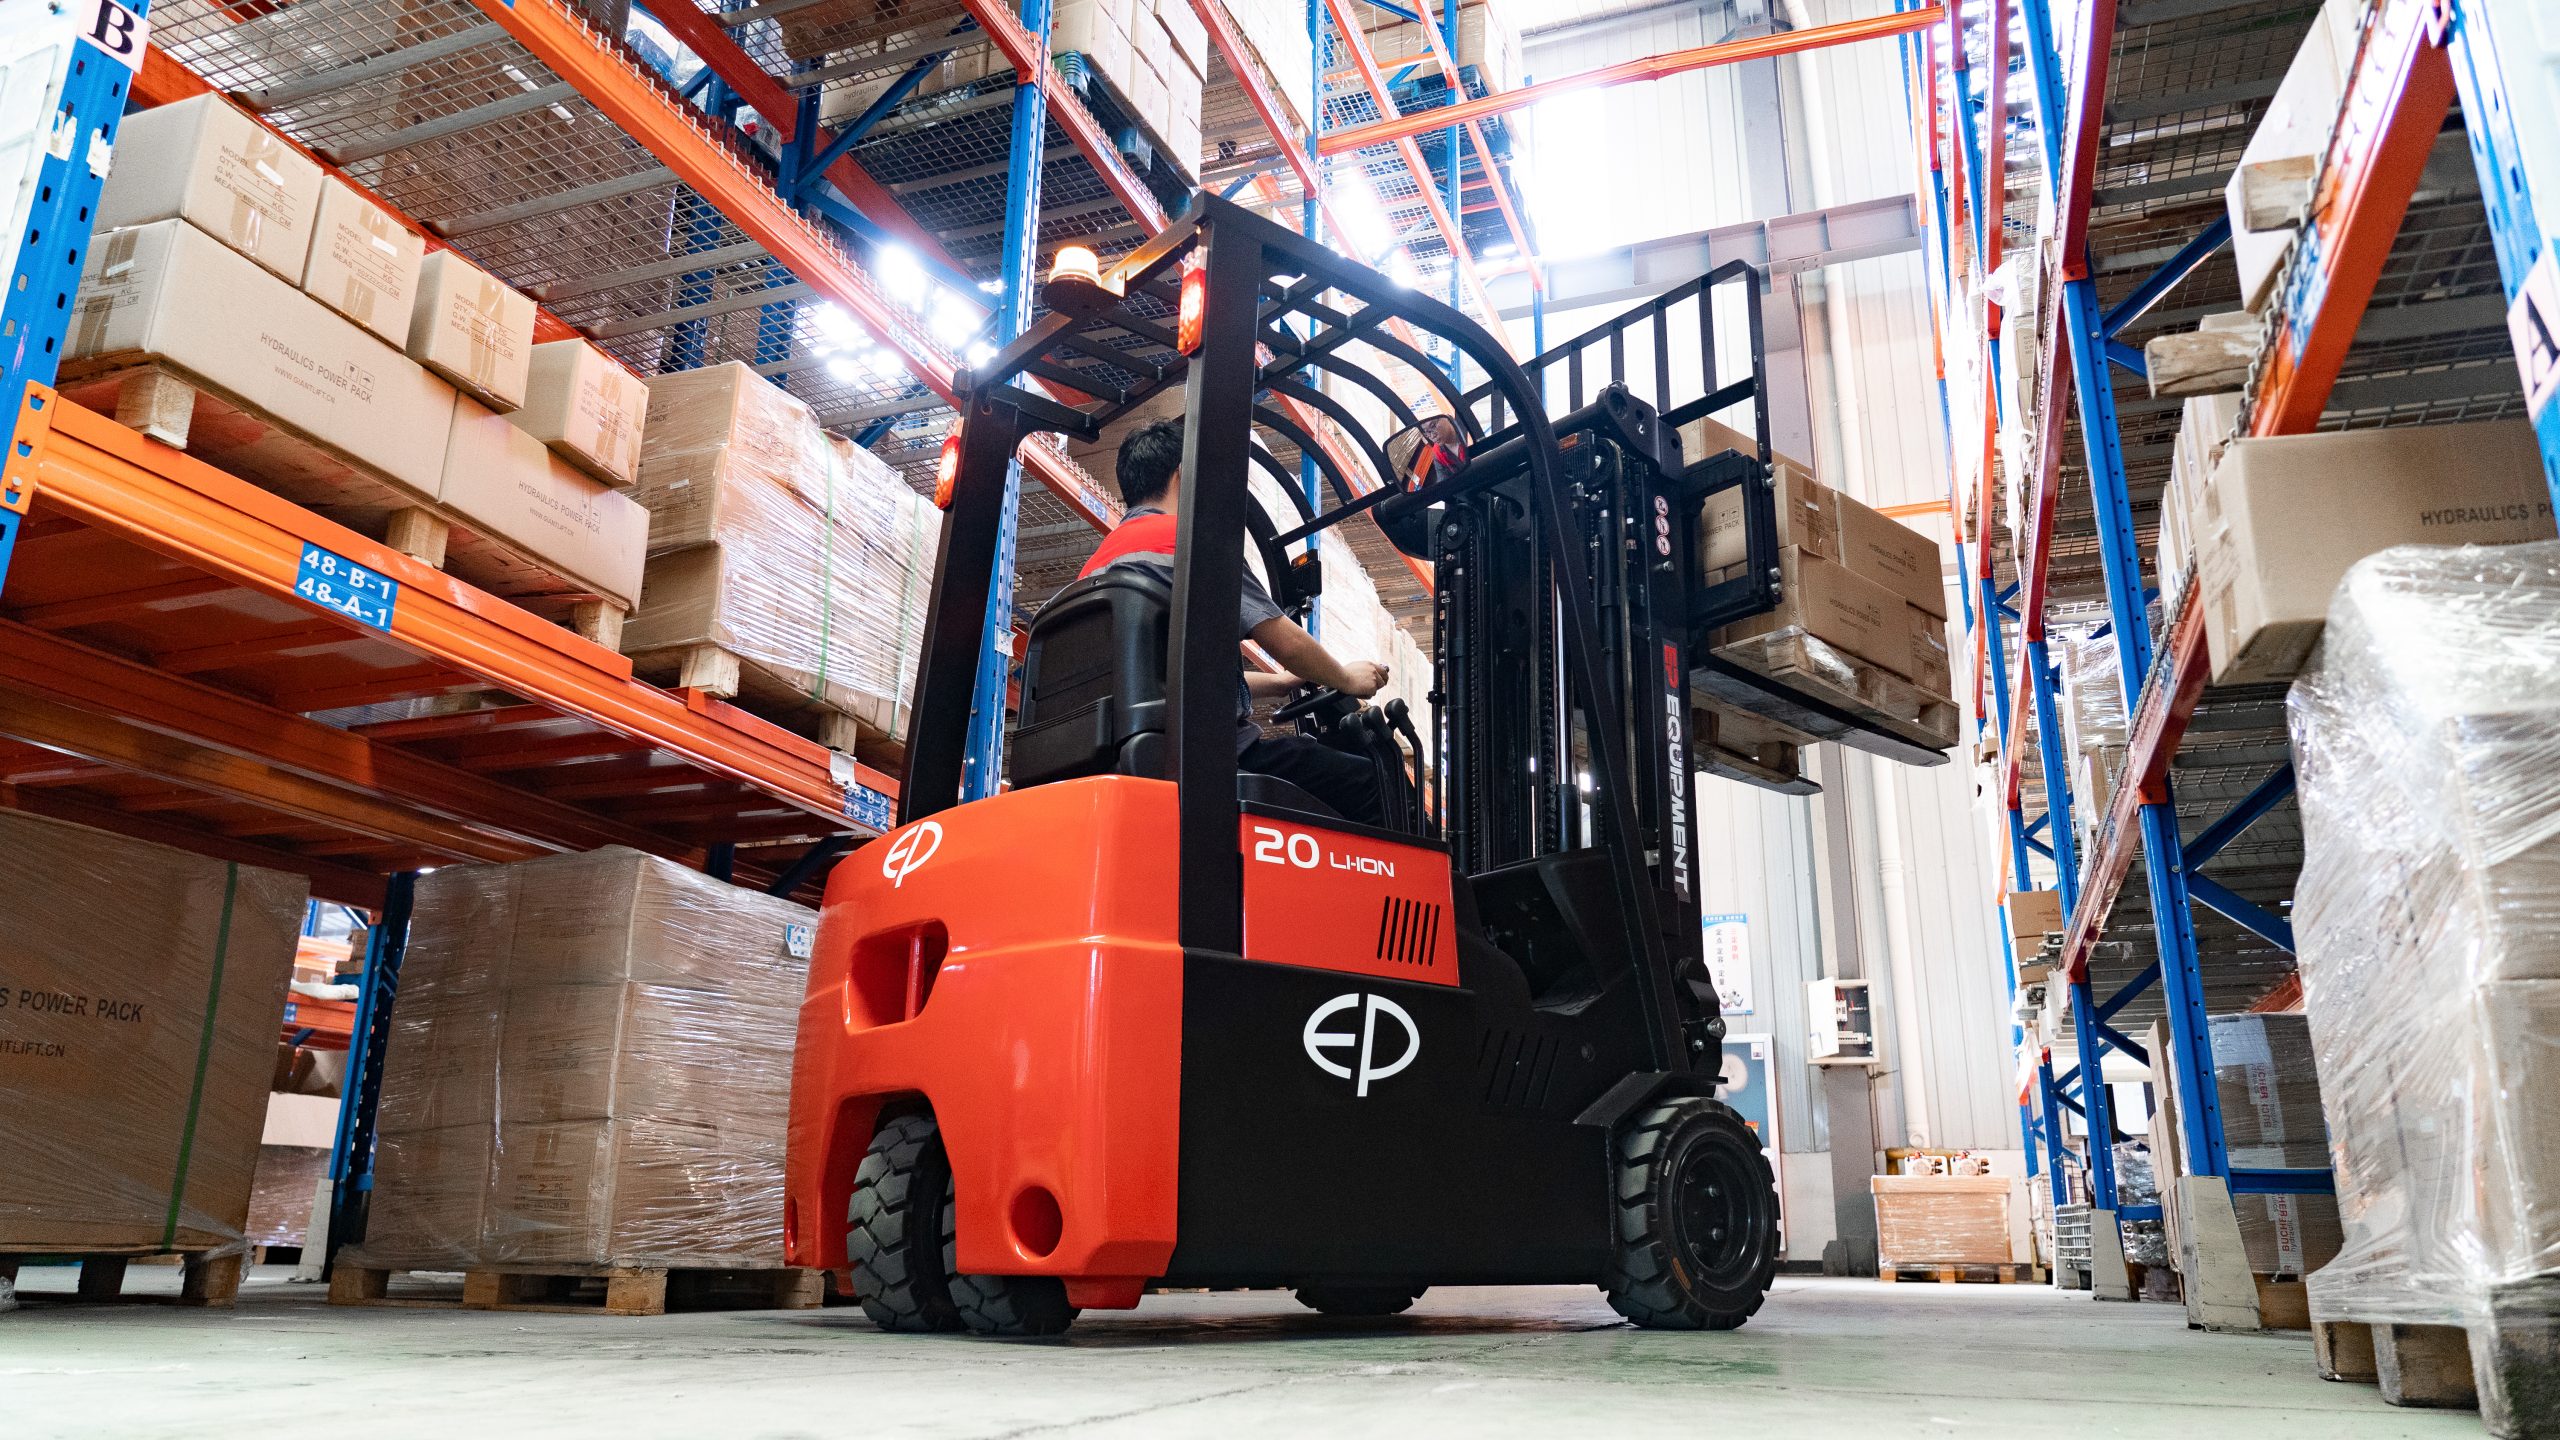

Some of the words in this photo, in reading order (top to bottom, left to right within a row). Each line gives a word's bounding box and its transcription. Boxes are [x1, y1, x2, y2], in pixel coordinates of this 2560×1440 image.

[87, 0, 134, 54] B
[260, 332, 315, 371] HYDRAULICS
[317, 365, 348, 391] POWER
[350, 384, 373, 405] PACK
[2526, 290, 2560, 397] A
[518, 480, 559, 510] HYDRAULICS
[560, 504, 583, 525] POWER
[2420, 503, 2530, 526] HYDRAULICS
[303, 550, 391, 600] 48-B-1
[298, 577, 388, 627] 48-A-1
[1663, 644, 1680, 690] EP
[1666, 693, 1689, 895] EQUIPMENT
[882, 820, 944, 889] EP
[1254, 826, 1320, 869] 20
[18, 989, 89, 1017] POWER
[96, 998, 145, 1023] PACK
[1303, 992, 1420, 1097] EP
